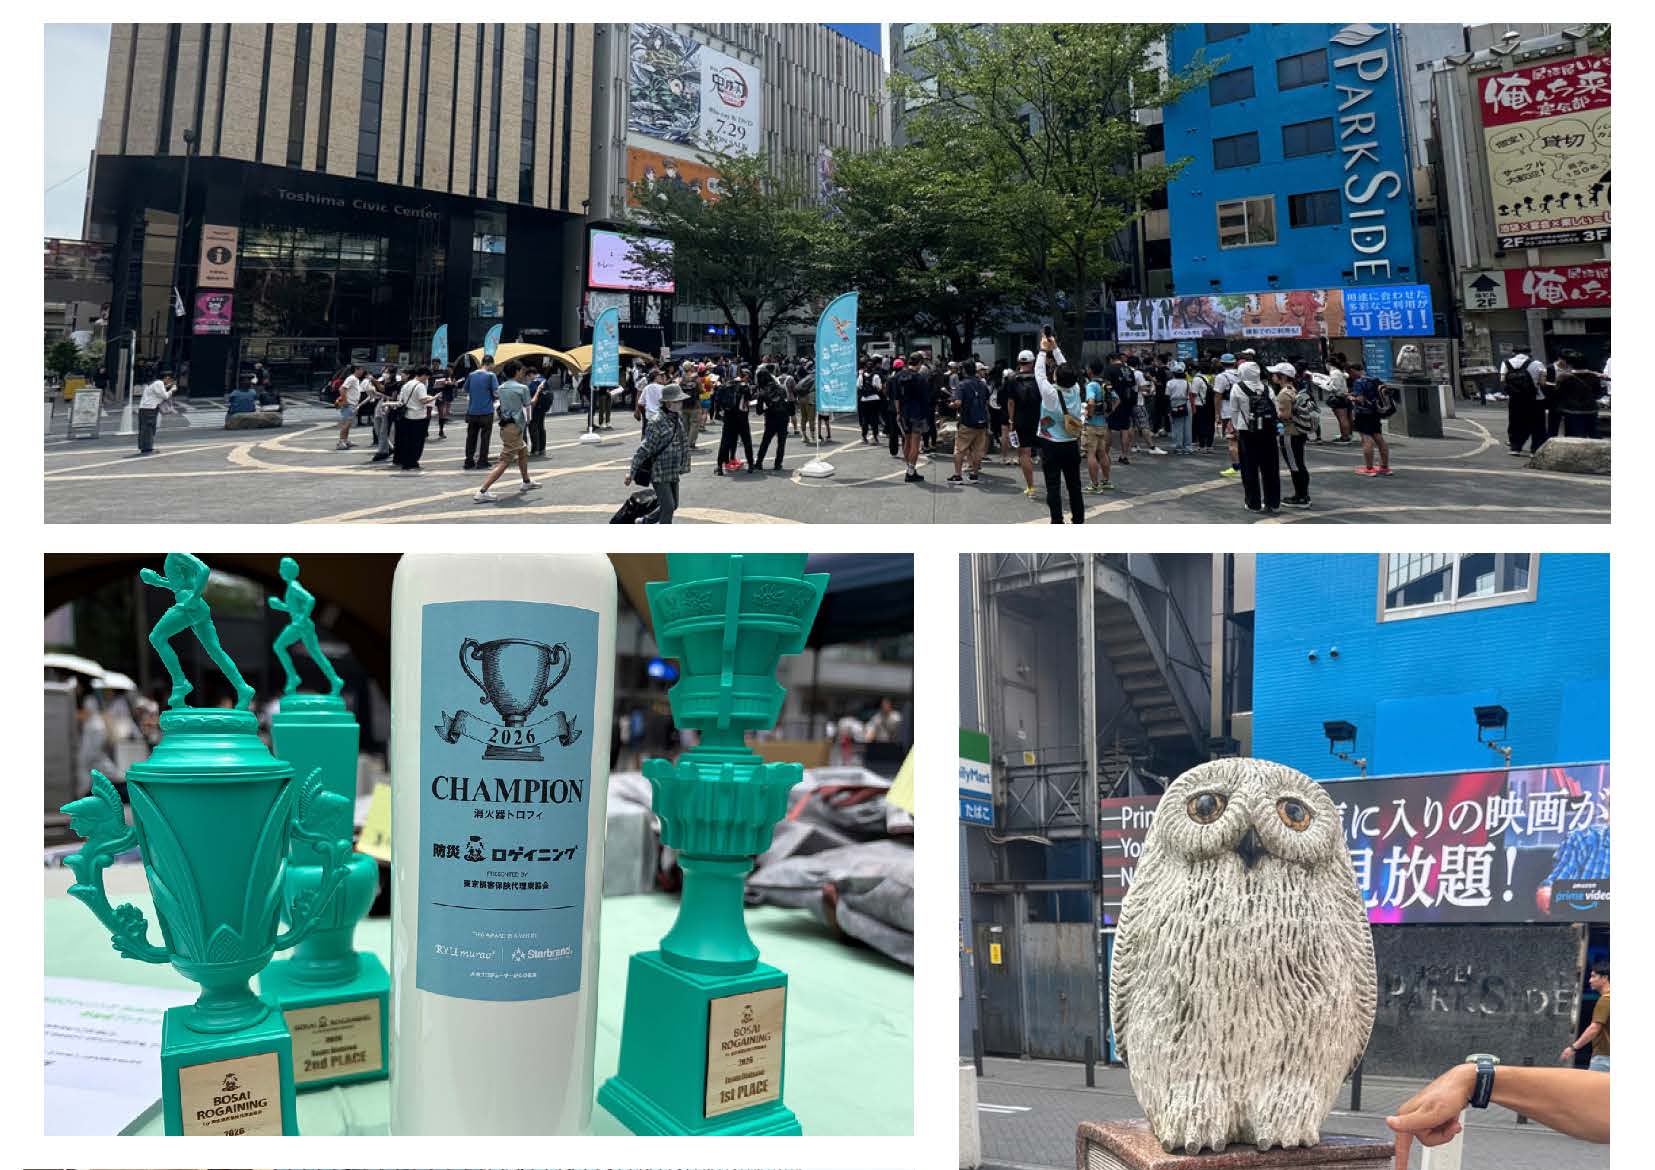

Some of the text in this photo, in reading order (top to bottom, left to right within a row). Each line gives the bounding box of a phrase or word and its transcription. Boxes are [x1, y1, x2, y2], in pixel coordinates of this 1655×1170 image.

[716, 119, 746, 141] 7.29
[279, 189, 441, 220] Toshima Civic Center
[1503, 236, 1525, 249] 2F
[1583, 229, 1608, 242] 3F
[488, 727, 536, 745] 2026
[431, 775, 584, 804] CHAMPION
[964, 803, 993, 820] たばこ
[432, 843, 579, 862] 防災 ロゲイニング
[733, 1023, 761, 1038] BOSAI
[721, 1032, 771, 1051] ROGAINING
[304, 1057, 328, 1072] 2nd
[331, 1050, 368, 1068] PLACE
[213, 1090, 251, 1107] BOSAI
[720, 1079, 769, 1104] 1st PLACE
[196, 1098, 268, 1121] ROGAINING
